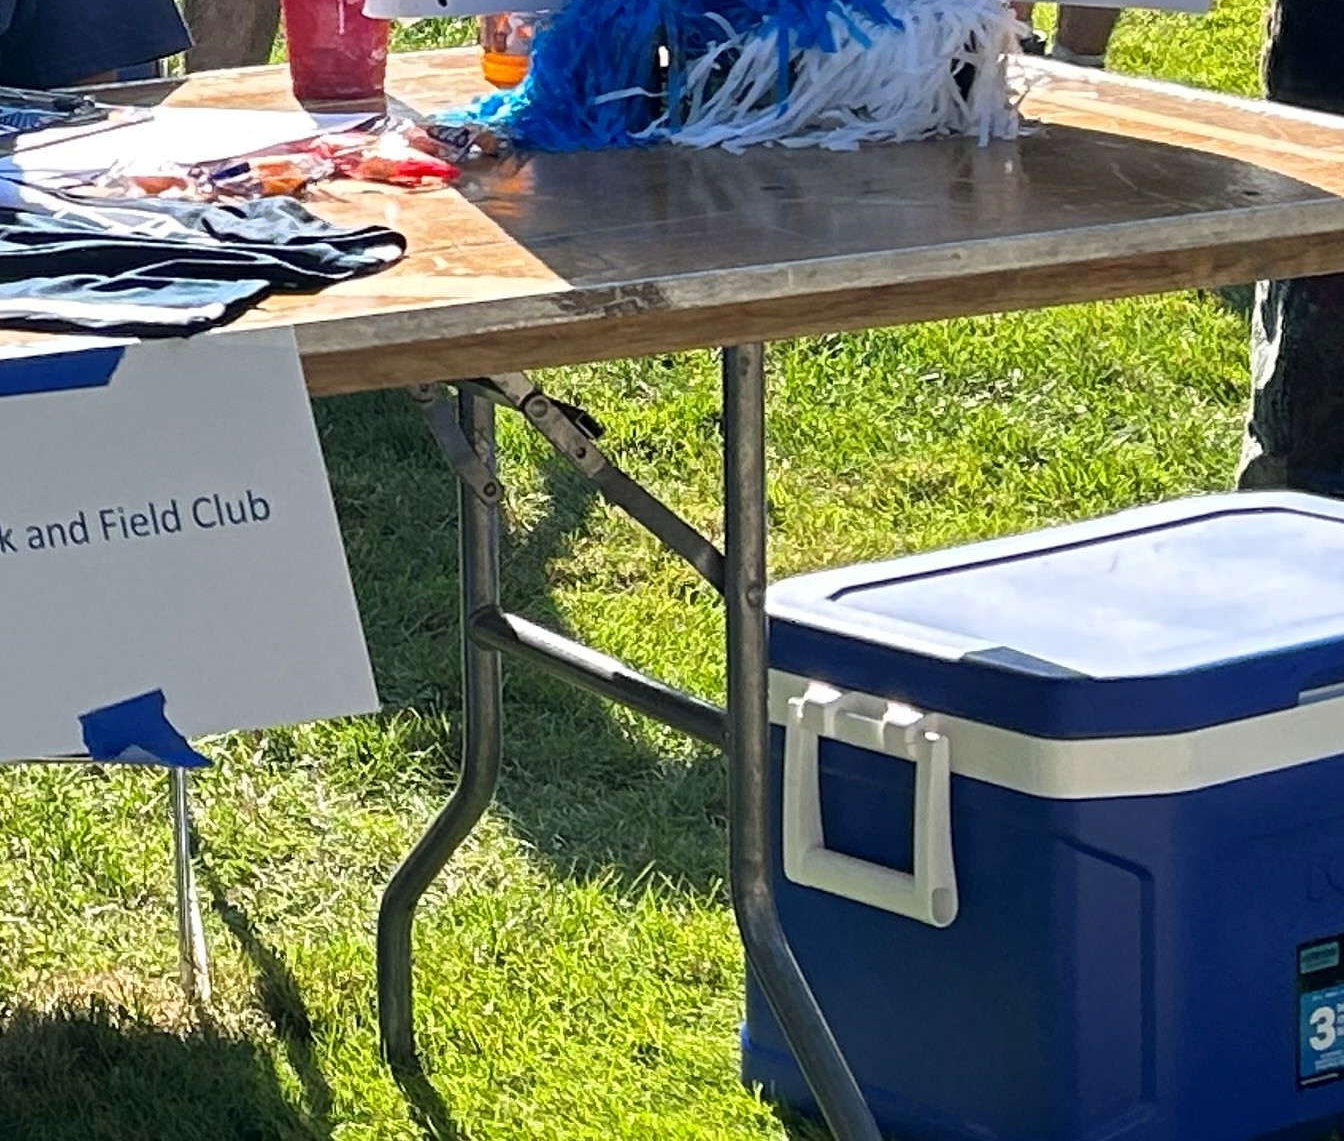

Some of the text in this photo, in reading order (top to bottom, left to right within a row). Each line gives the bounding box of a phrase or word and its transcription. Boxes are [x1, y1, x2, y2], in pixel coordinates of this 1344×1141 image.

[26, 511, 90, 551] and
[98, 499, 183, 541] Field
[191, 490, 272, 529] Club
